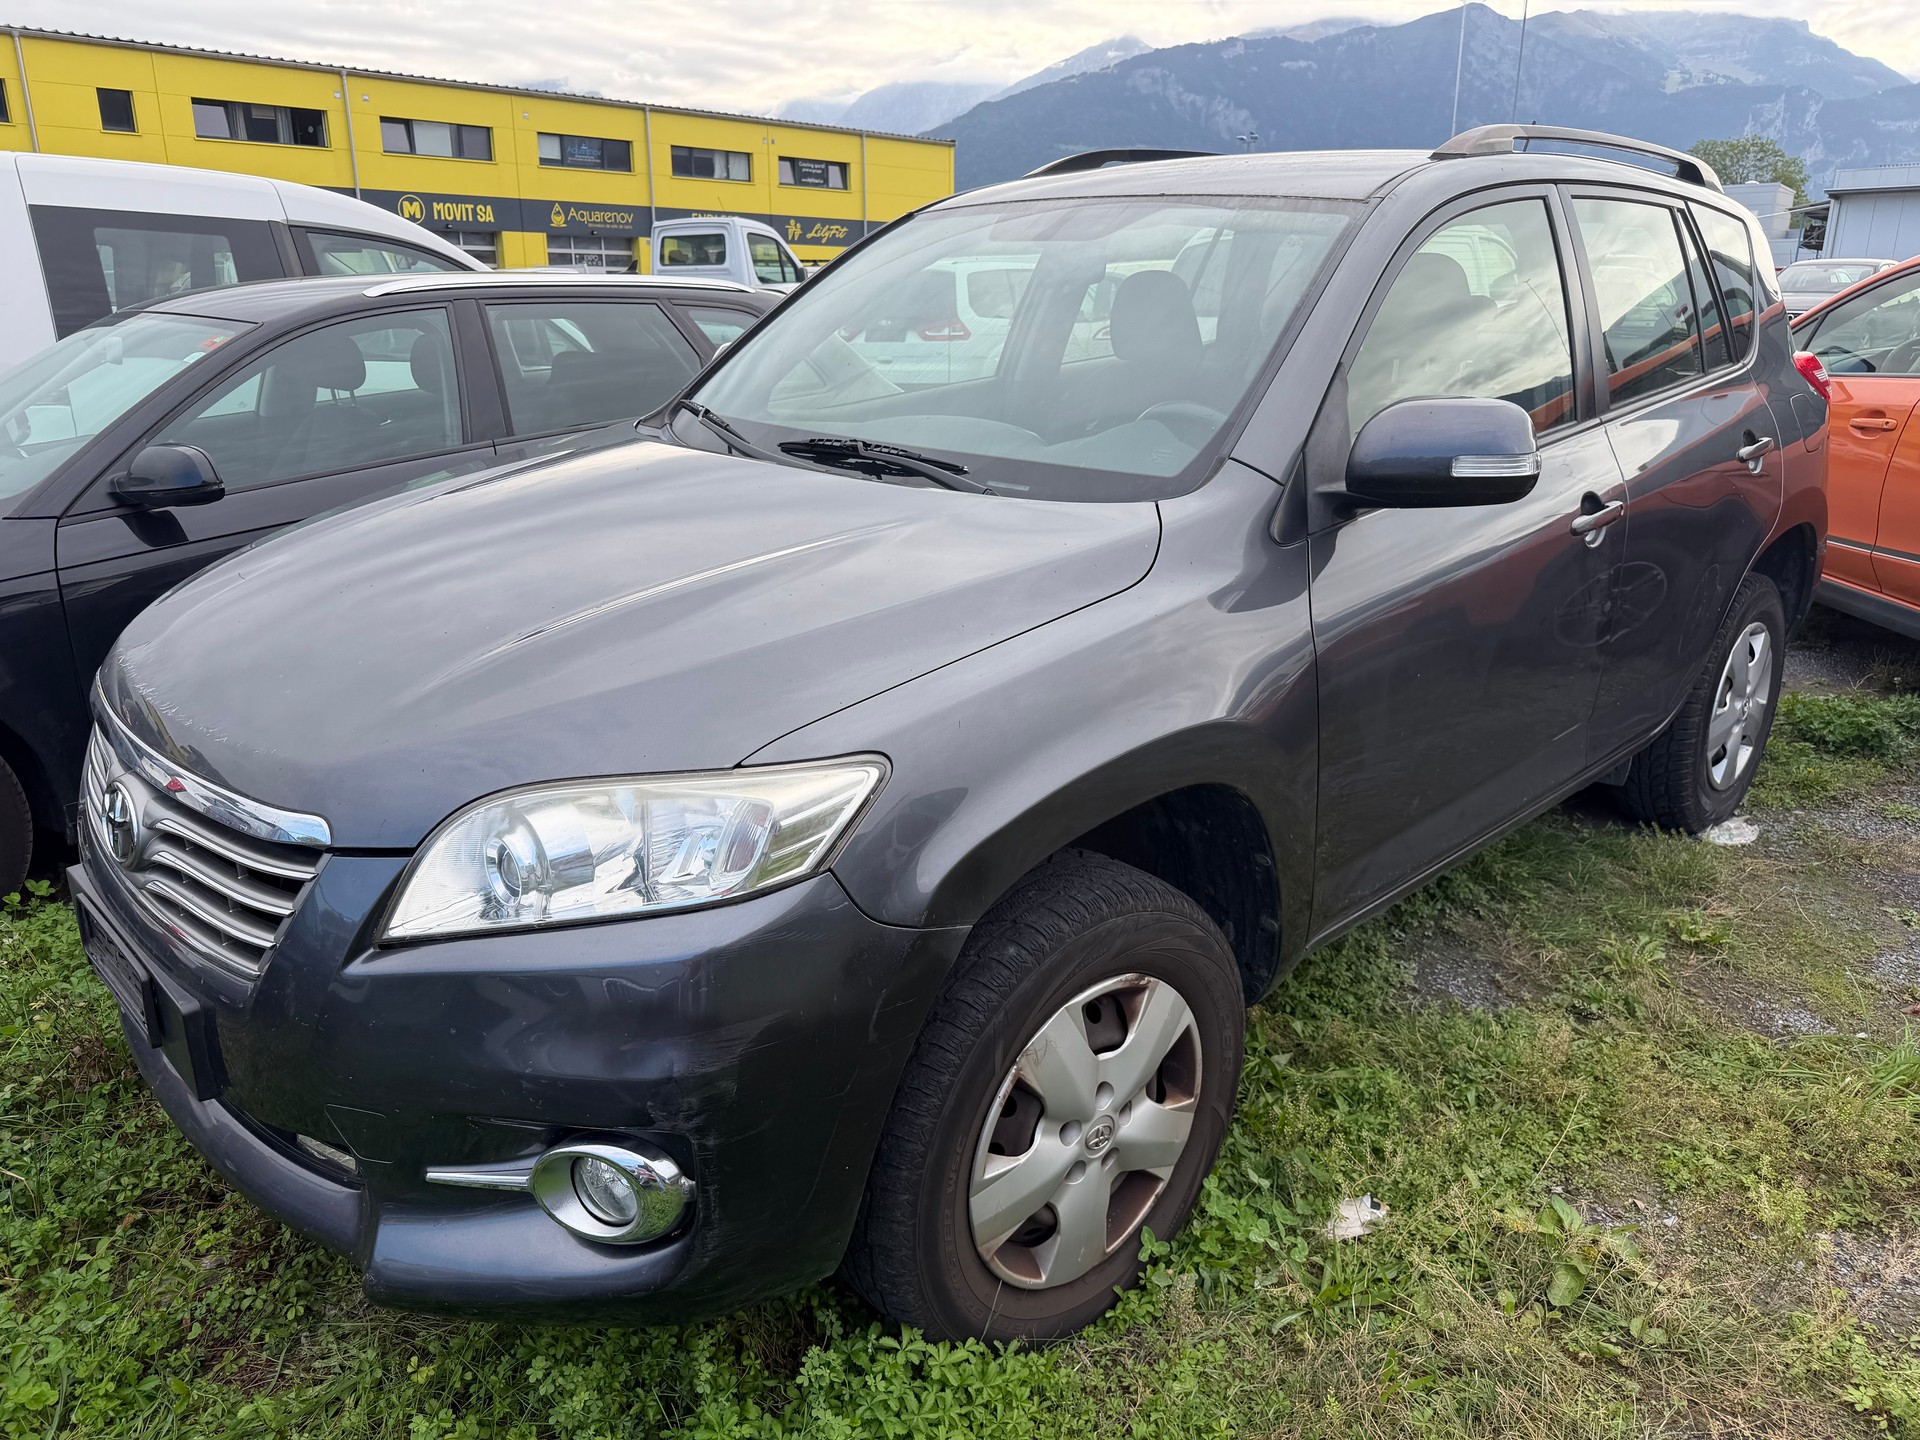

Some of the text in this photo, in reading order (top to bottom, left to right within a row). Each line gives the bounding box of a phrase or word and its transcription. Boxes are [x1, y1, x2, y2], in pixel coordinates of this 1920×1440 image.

[402, 201, 495, 223] M MOVIT SA
[567, 207, 634, 225] Aquarenov
[806, 223, 849, 244] LilyFit
